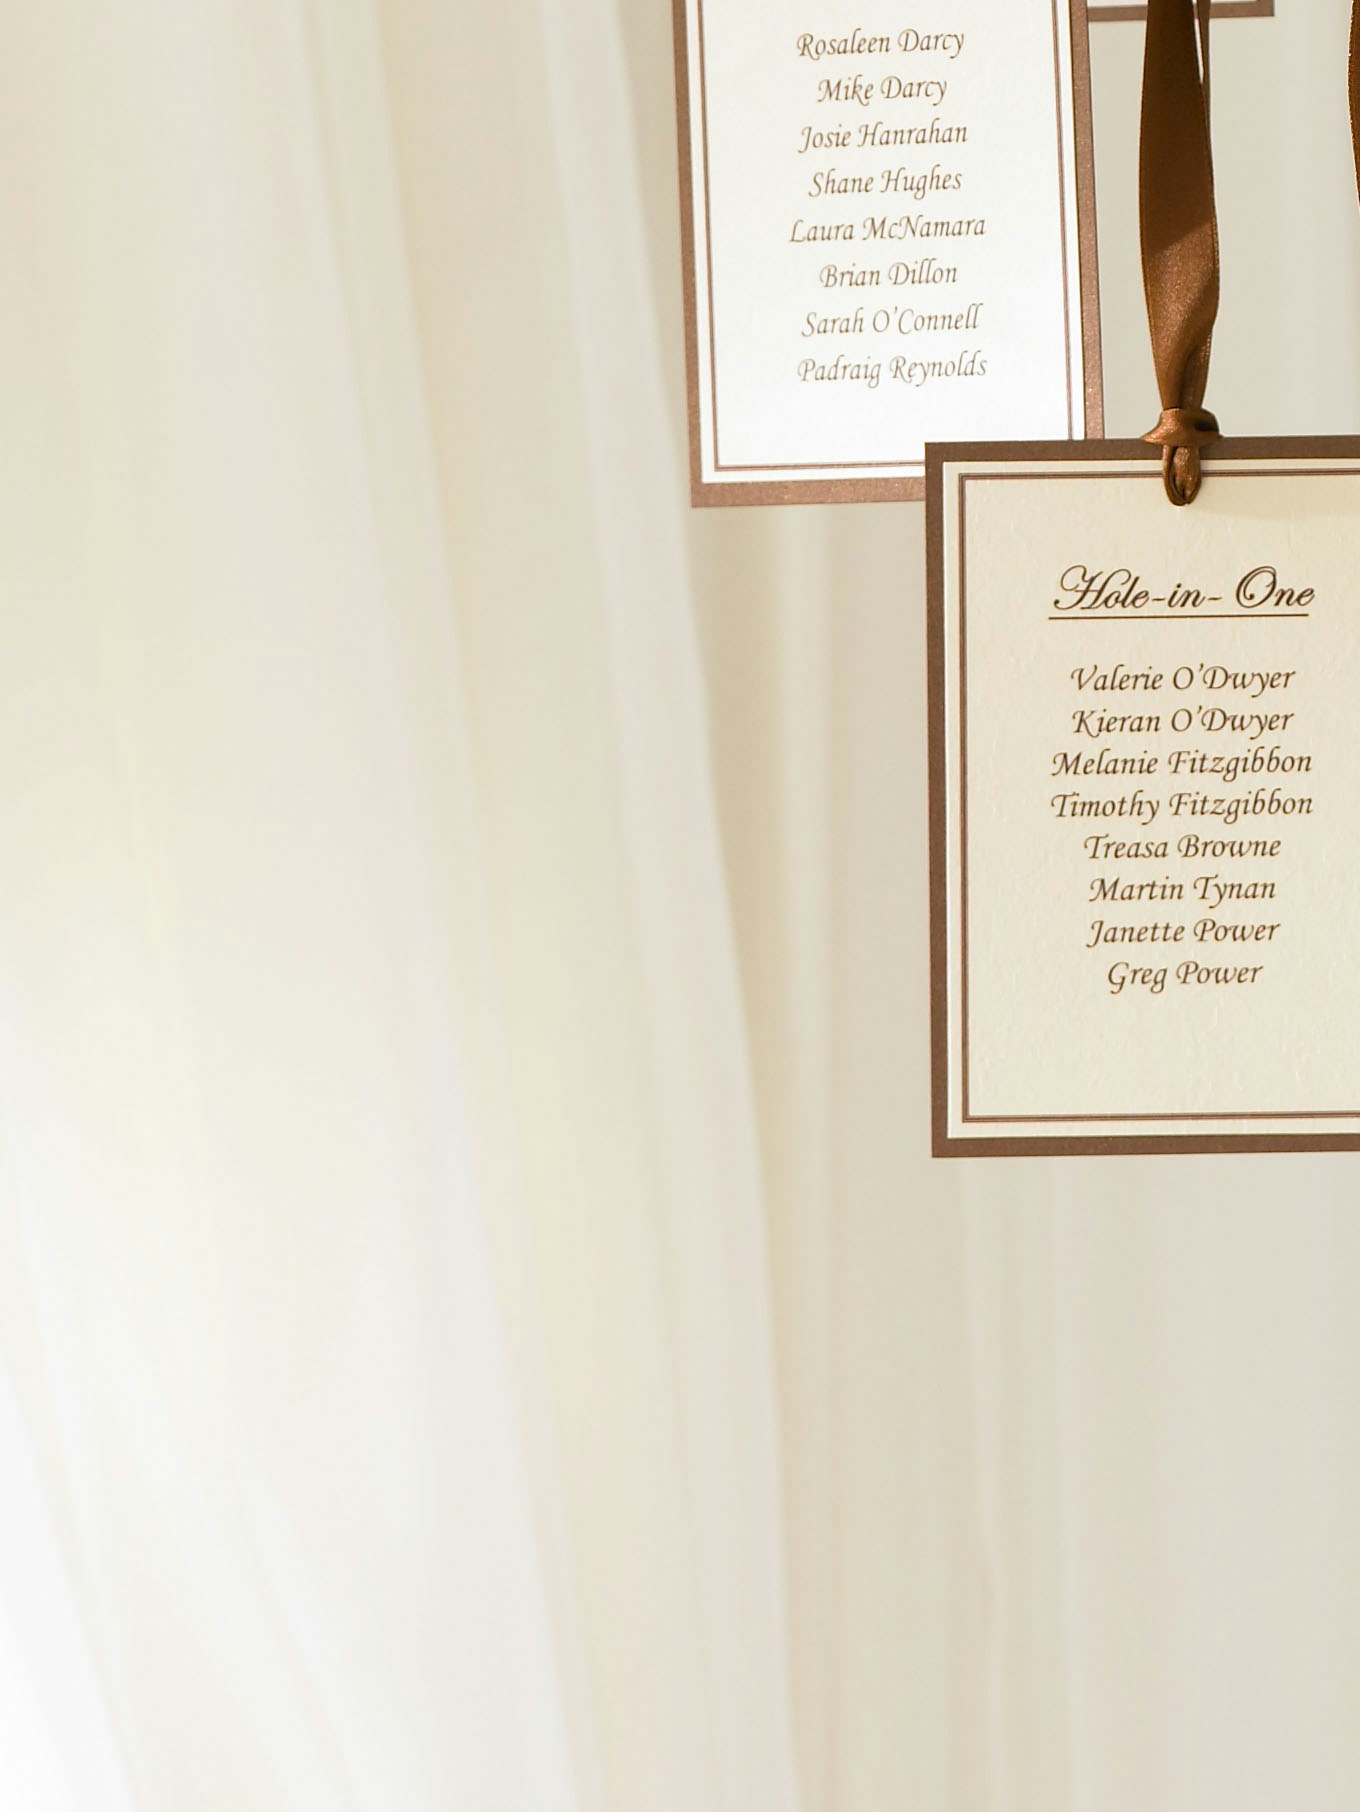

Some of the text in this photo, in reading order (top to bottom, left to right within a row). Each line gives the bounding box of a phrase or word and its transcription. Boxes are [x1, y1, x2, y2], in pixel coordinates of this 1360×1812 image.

[796, 27, 965, 61] Rosaleen Darcy
[817, 73, 948, 107] Mike Darcy
[797, 117, 967, 154] Josie Hanrahan
[807, 163, 963, 201] Shane Hughes
[789, 214, 986, 243] Laura McNamara
[819, 257, 957, 288] Brian Dillon
[801, 302, 984, 337] Sarah O'Connell
[797, 349, 987, 389] Padraig Reynolds
[1235, 565, 1316, 609] One
[1070, 662, 1296, 699] Valerie O'Dwyer
[1071, 704, 1295, 741] Kieran O'Dwyer
[1051, 745, 1312, 783] Melanie Fitzgibbon
[1050, 787, 1313, 826] Timothy Fitzgibbon
[1083, 833, 1282, 859] Treasa Browne
[1088, 873, 1276, 910] Martin Tynan
[1085, 918, 1281, 948] Janette Power
[1107, 960, 1264, 995] Greg Power
